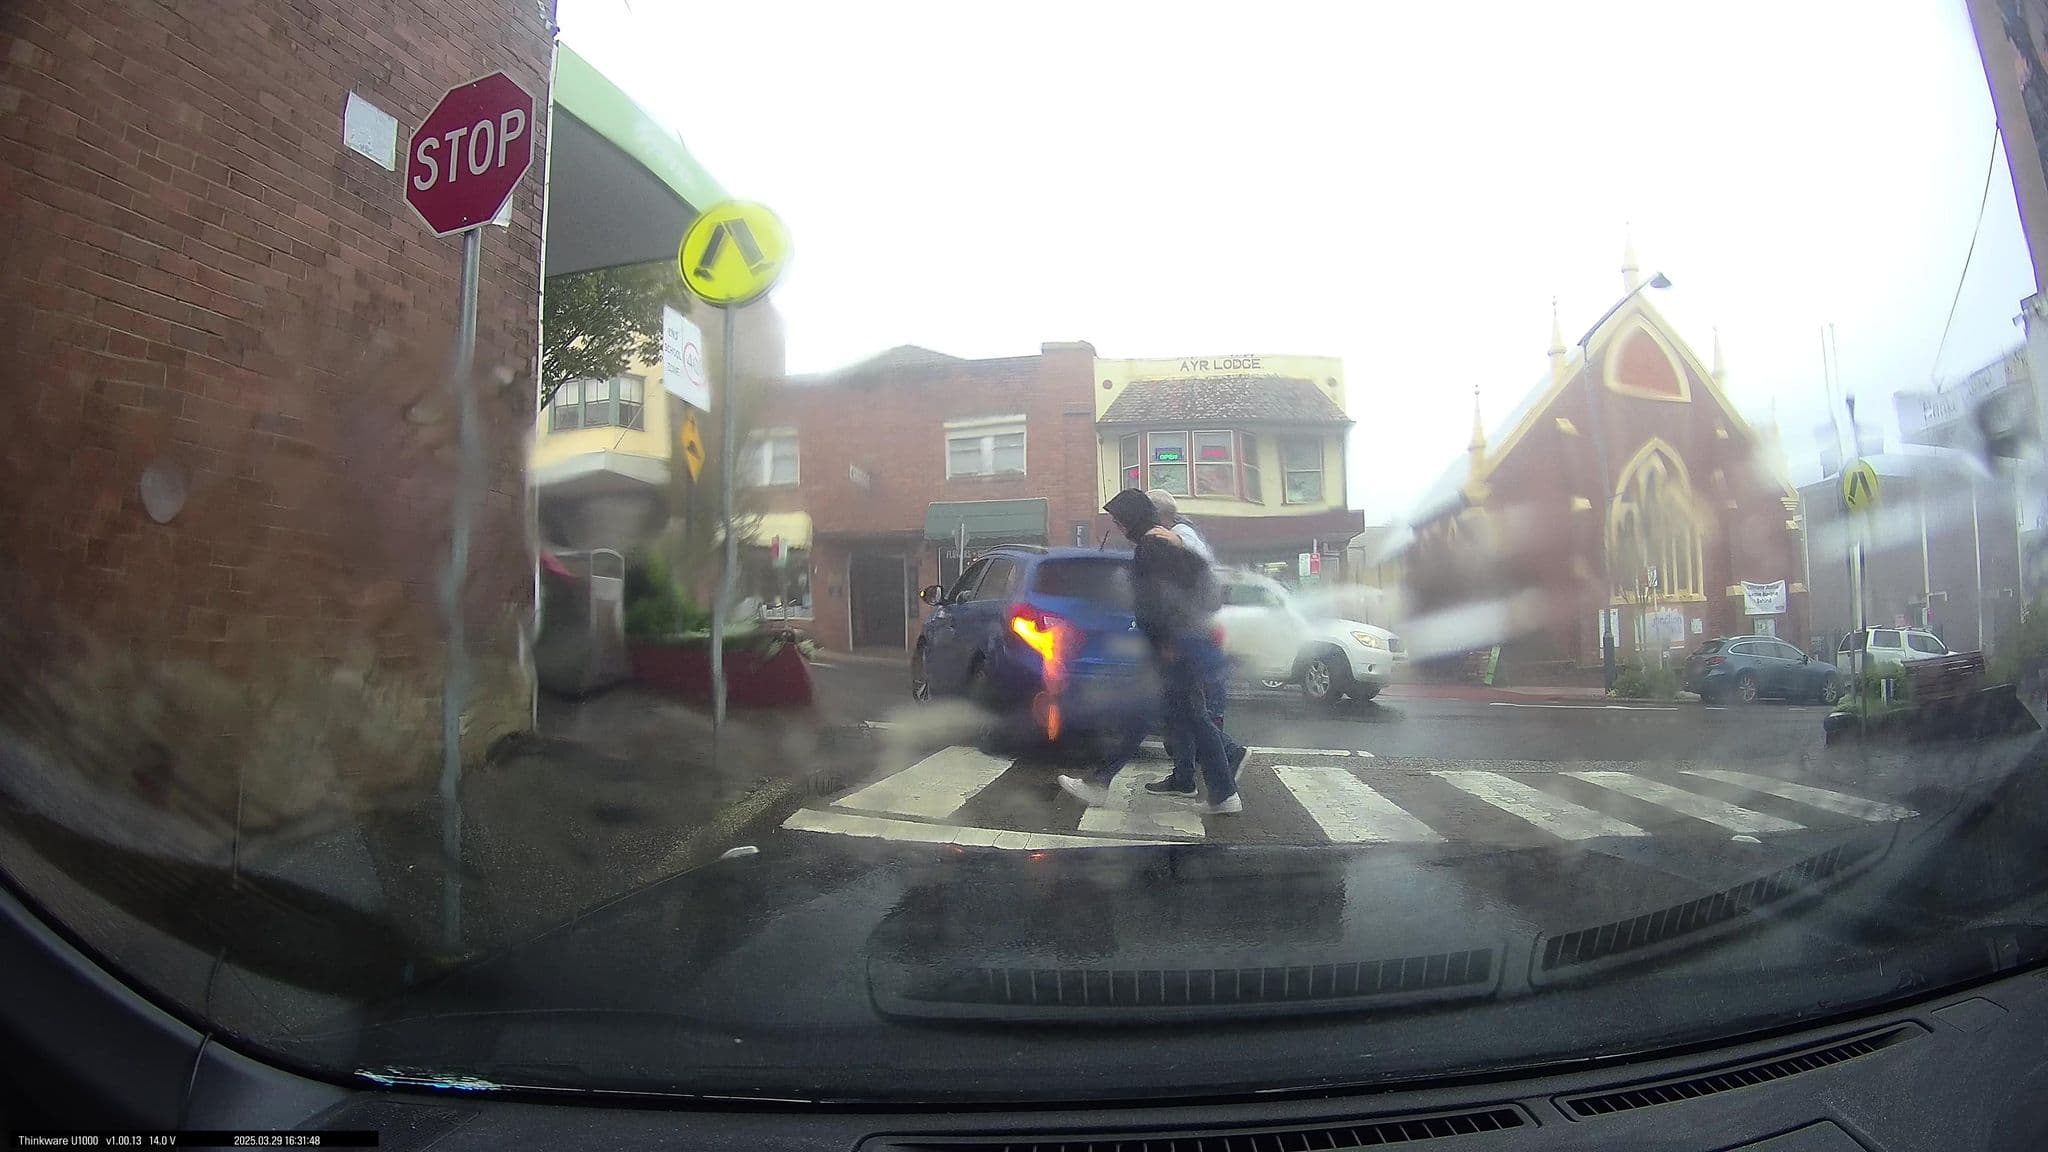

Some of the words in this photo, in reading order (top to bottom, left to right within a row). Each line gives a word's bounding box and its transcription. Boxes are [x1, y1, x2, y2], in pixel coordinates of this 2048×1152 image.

[413, 108, 526, 191] STOP
[1180, 360, 1209, 372] AYR
[1213, 358, 1261, 370] LODGE
